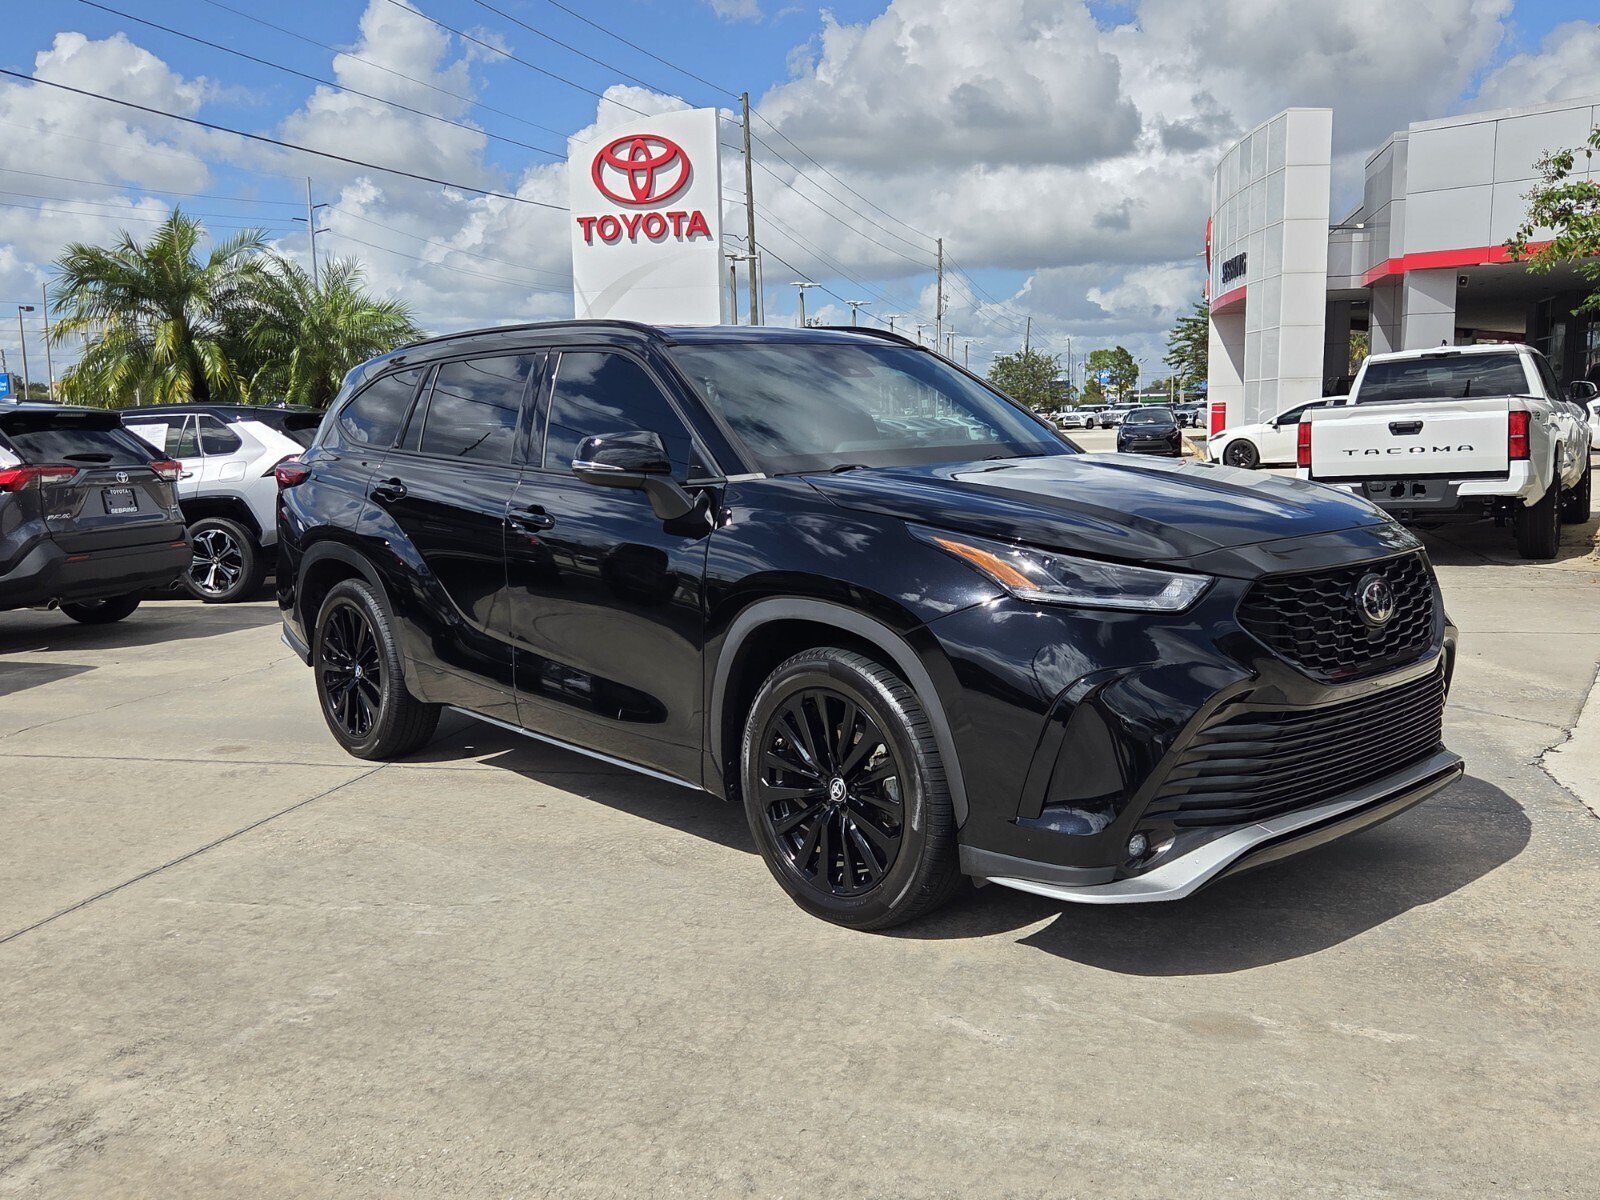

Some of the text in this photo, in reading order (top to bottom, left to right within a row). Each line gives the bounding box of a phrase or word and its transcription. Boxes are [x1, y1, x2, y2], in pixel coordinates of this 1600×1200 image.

[577, 210, 710, 243] TOYOTA
[1342, 445, 1474, 456] TACOMA
[111, 506, 138, 514] SEBRING
